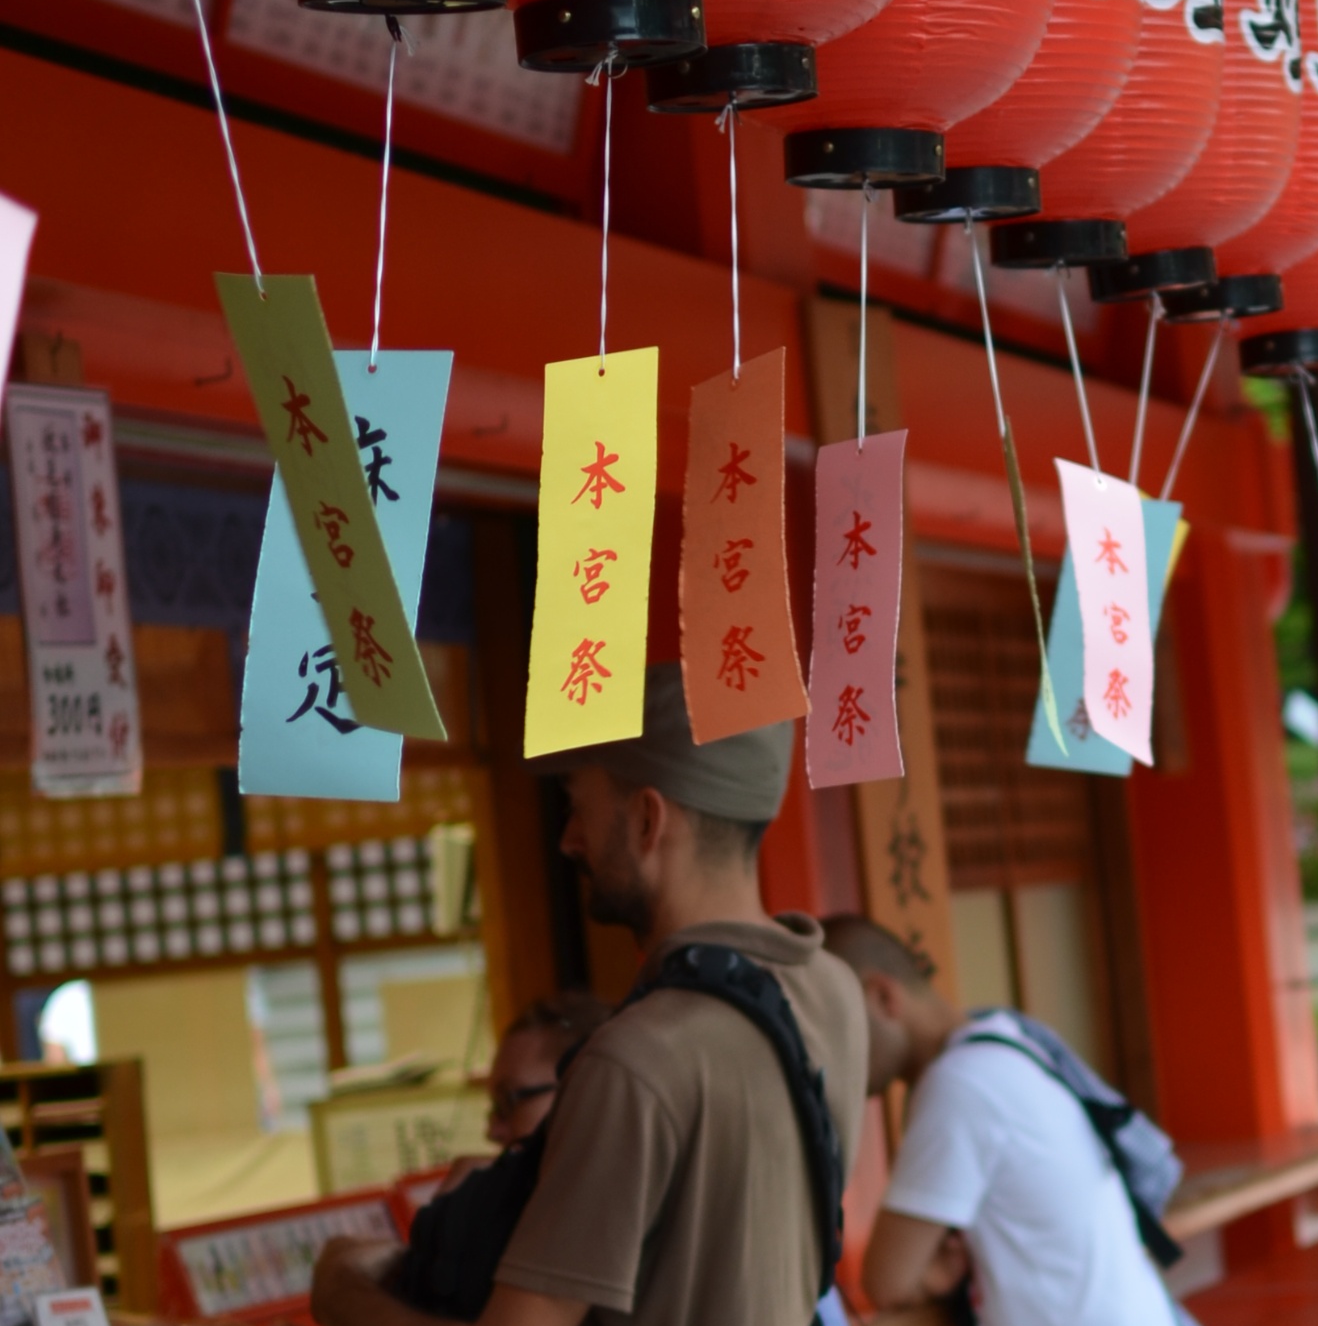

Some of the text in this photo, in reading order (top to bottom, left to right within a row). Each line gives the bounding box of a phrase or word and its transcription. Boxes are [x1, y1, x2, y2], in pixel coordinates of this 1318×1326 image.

[281, 376, 394, 687] 本宮祭
[560, 441, 625, 706] 本宮祭
[710, 442, 766, 692] 本宮祭
[832, 511, 877, 746] 本宮祭
[1094, 527, 1134, 720] 本宮祭
